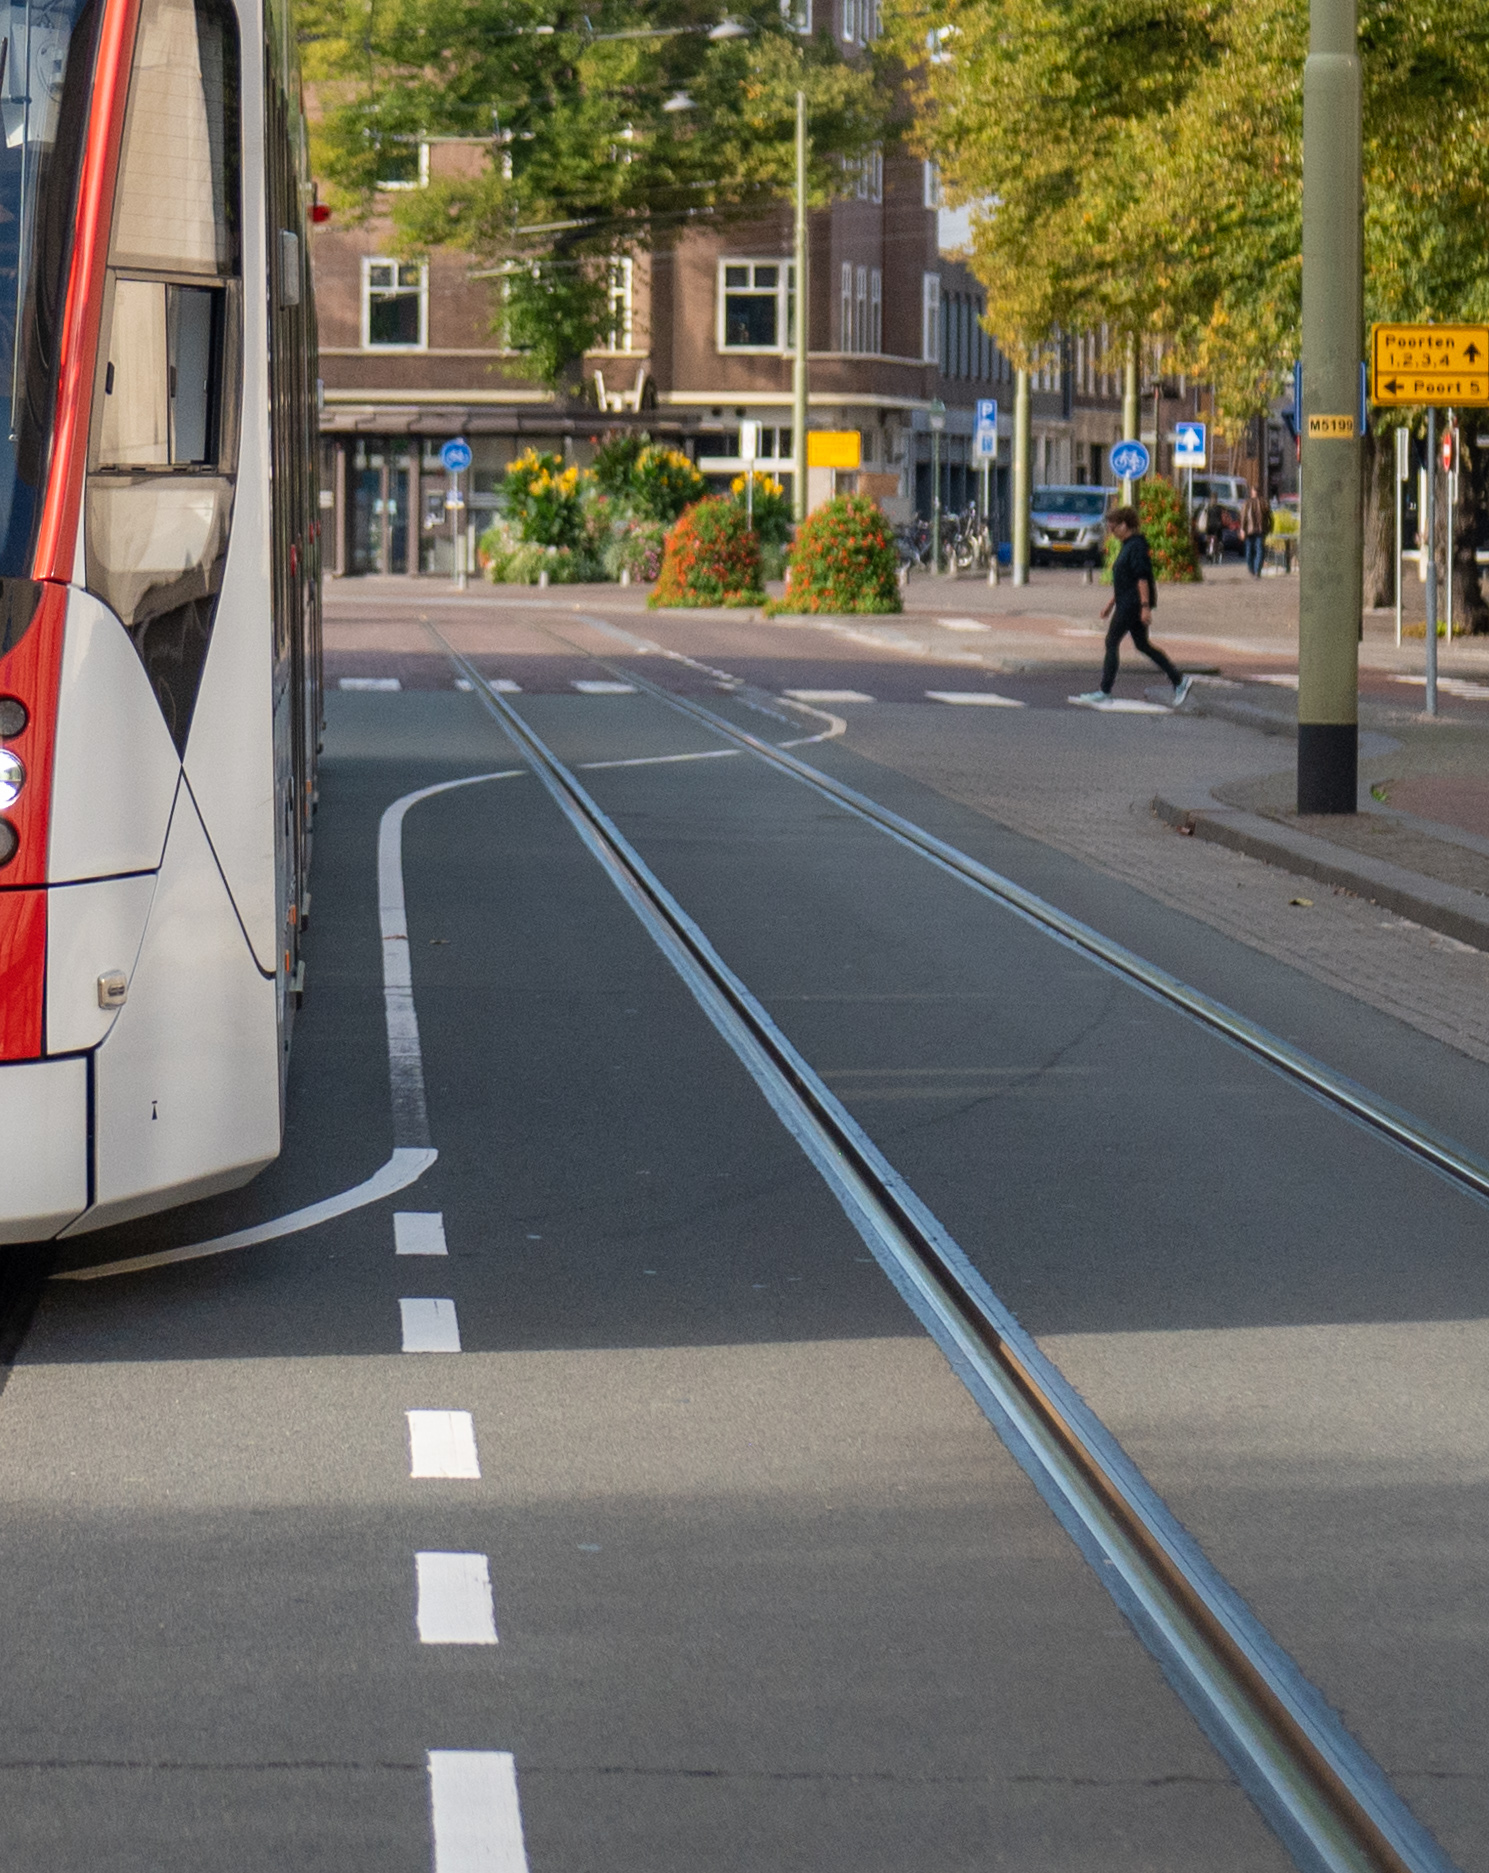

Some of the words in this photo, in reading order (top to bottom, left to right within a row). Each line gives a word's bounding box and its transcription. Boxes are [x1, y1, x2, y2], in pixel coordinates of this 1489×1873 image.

[1385, 334, 1455, 348] Poorten
[1413, 379, 1462, 395] Poort
[1470, 380, 1481, 395] 5
